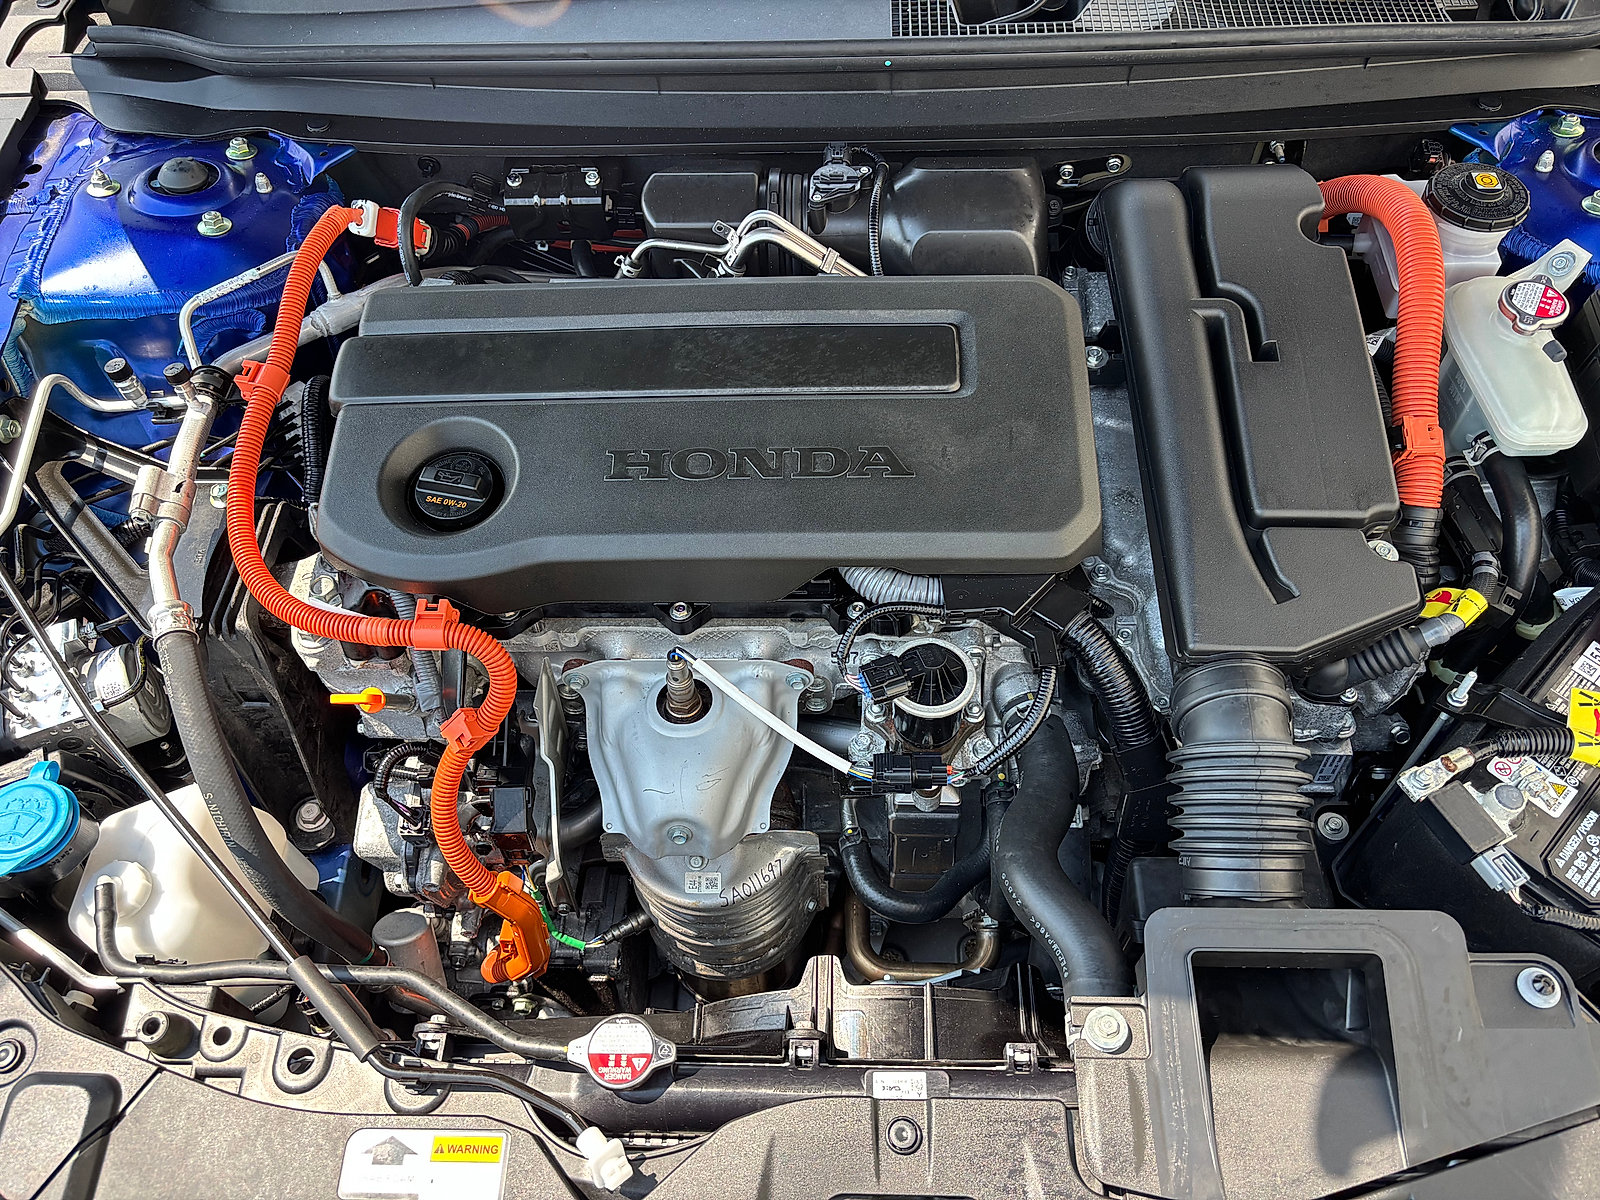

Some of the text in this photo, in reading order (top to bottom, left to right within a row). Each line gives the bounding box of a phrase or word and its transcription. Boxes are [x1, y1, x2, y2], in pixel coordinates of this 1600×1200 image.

[603, 445, 916, 481] HONDA
[425, 495, 443, 505] SAE
[443, 498, 468, 509] 0W-20
[447, 1144, 499, 1155] WARNING
